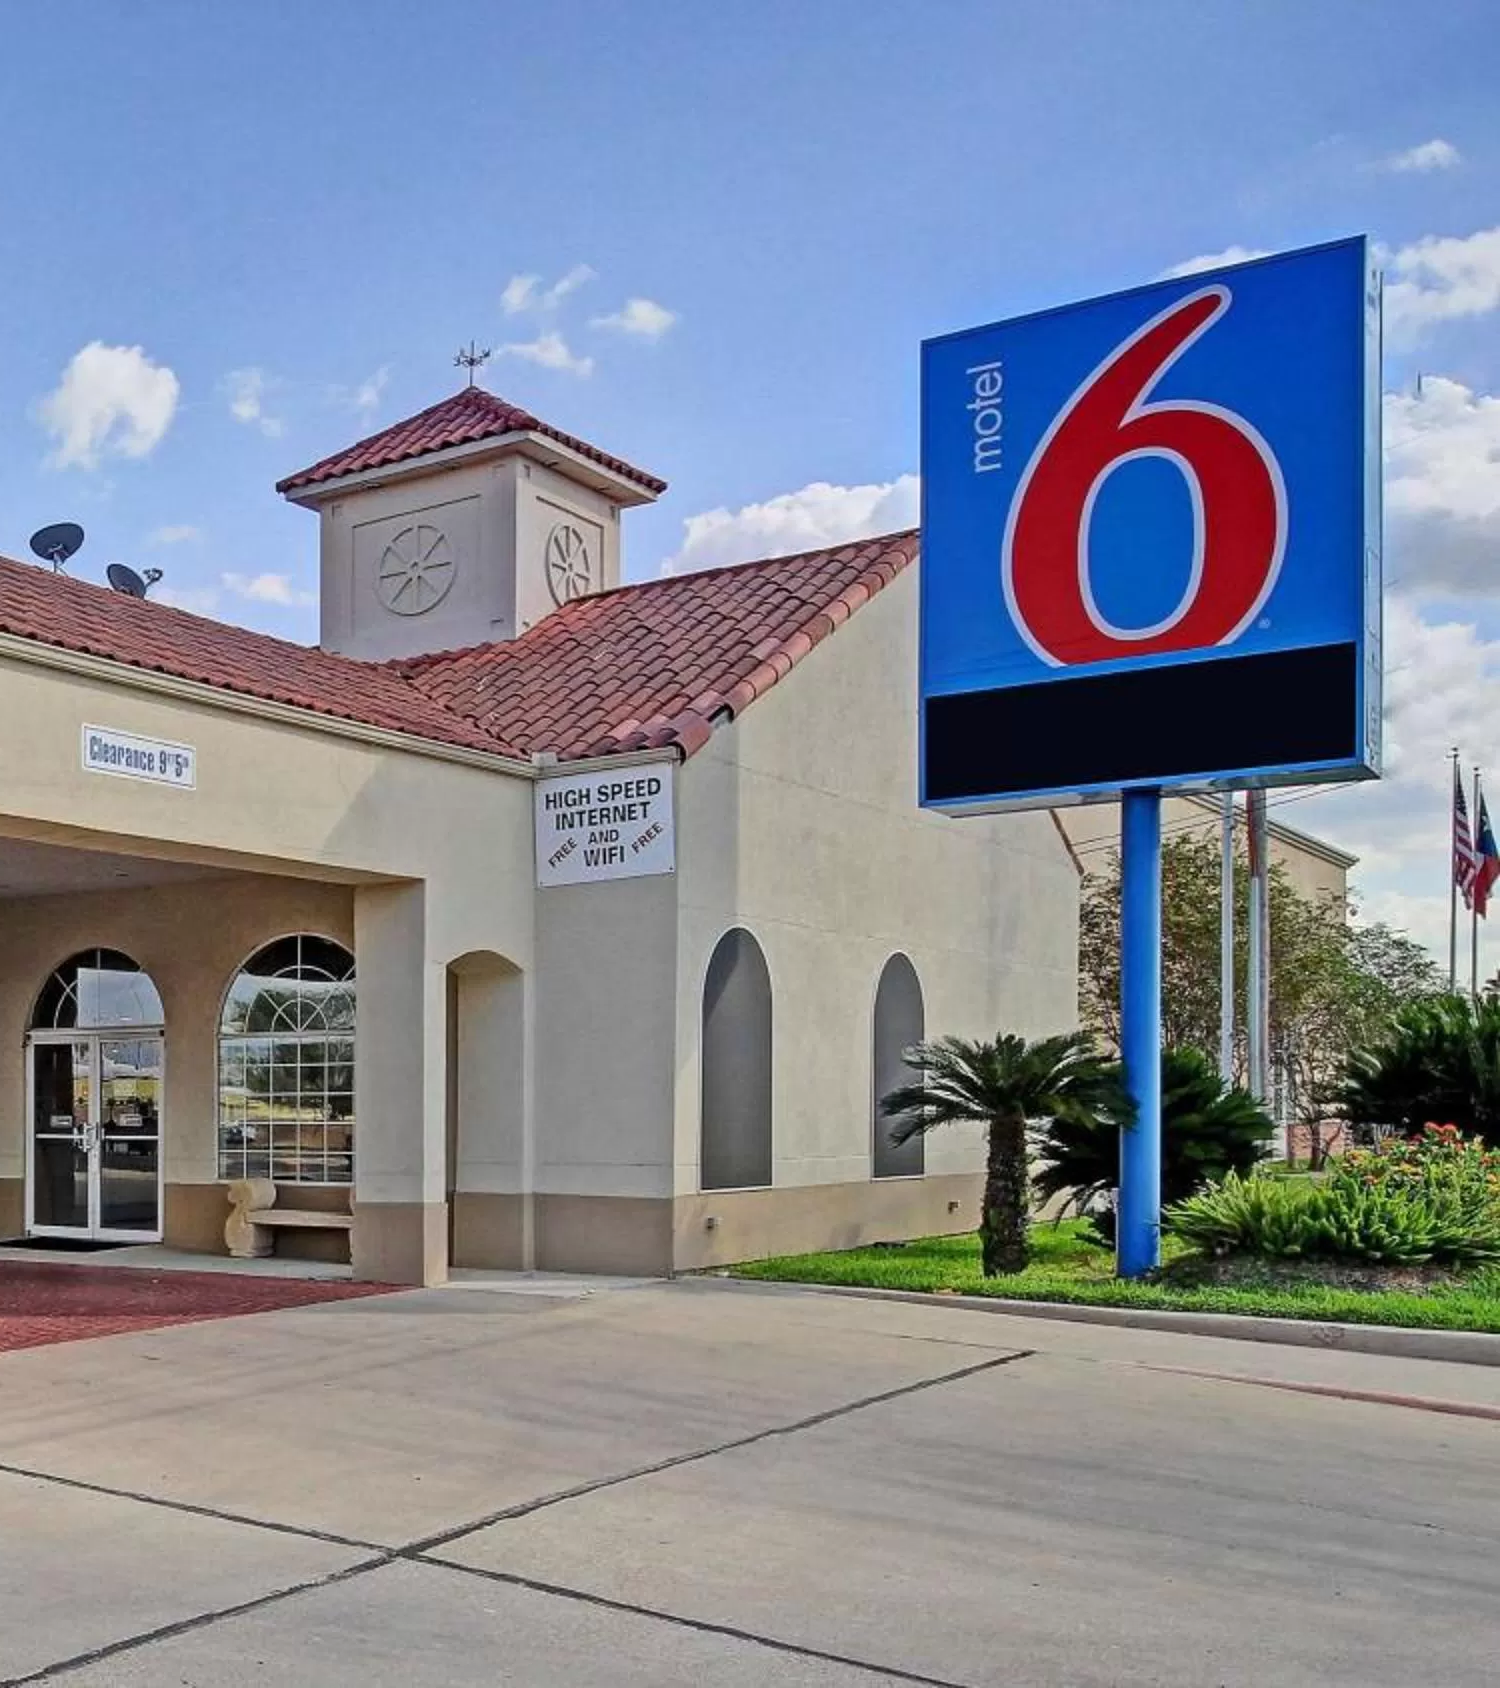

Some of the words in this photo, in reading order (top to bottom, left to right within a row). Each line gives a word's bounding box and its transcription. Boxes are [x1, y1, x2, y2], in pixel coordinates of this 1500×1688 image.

[966, 361, 1002, 474] motel
[1001, 283, 1289, 668] 6
[89, 735, 155, 773] Clearance
[545, 787, 591, 811] HIGH
[597, 777, 662, 803] SPEED
[555, 801, 651, 831] INTERNET
[548, 837, 578, 869] FREE
[588, 829, 620, 845] AND
[631, 822, 664, 854] FREE
[584, 846, 625, 867] WIFI
